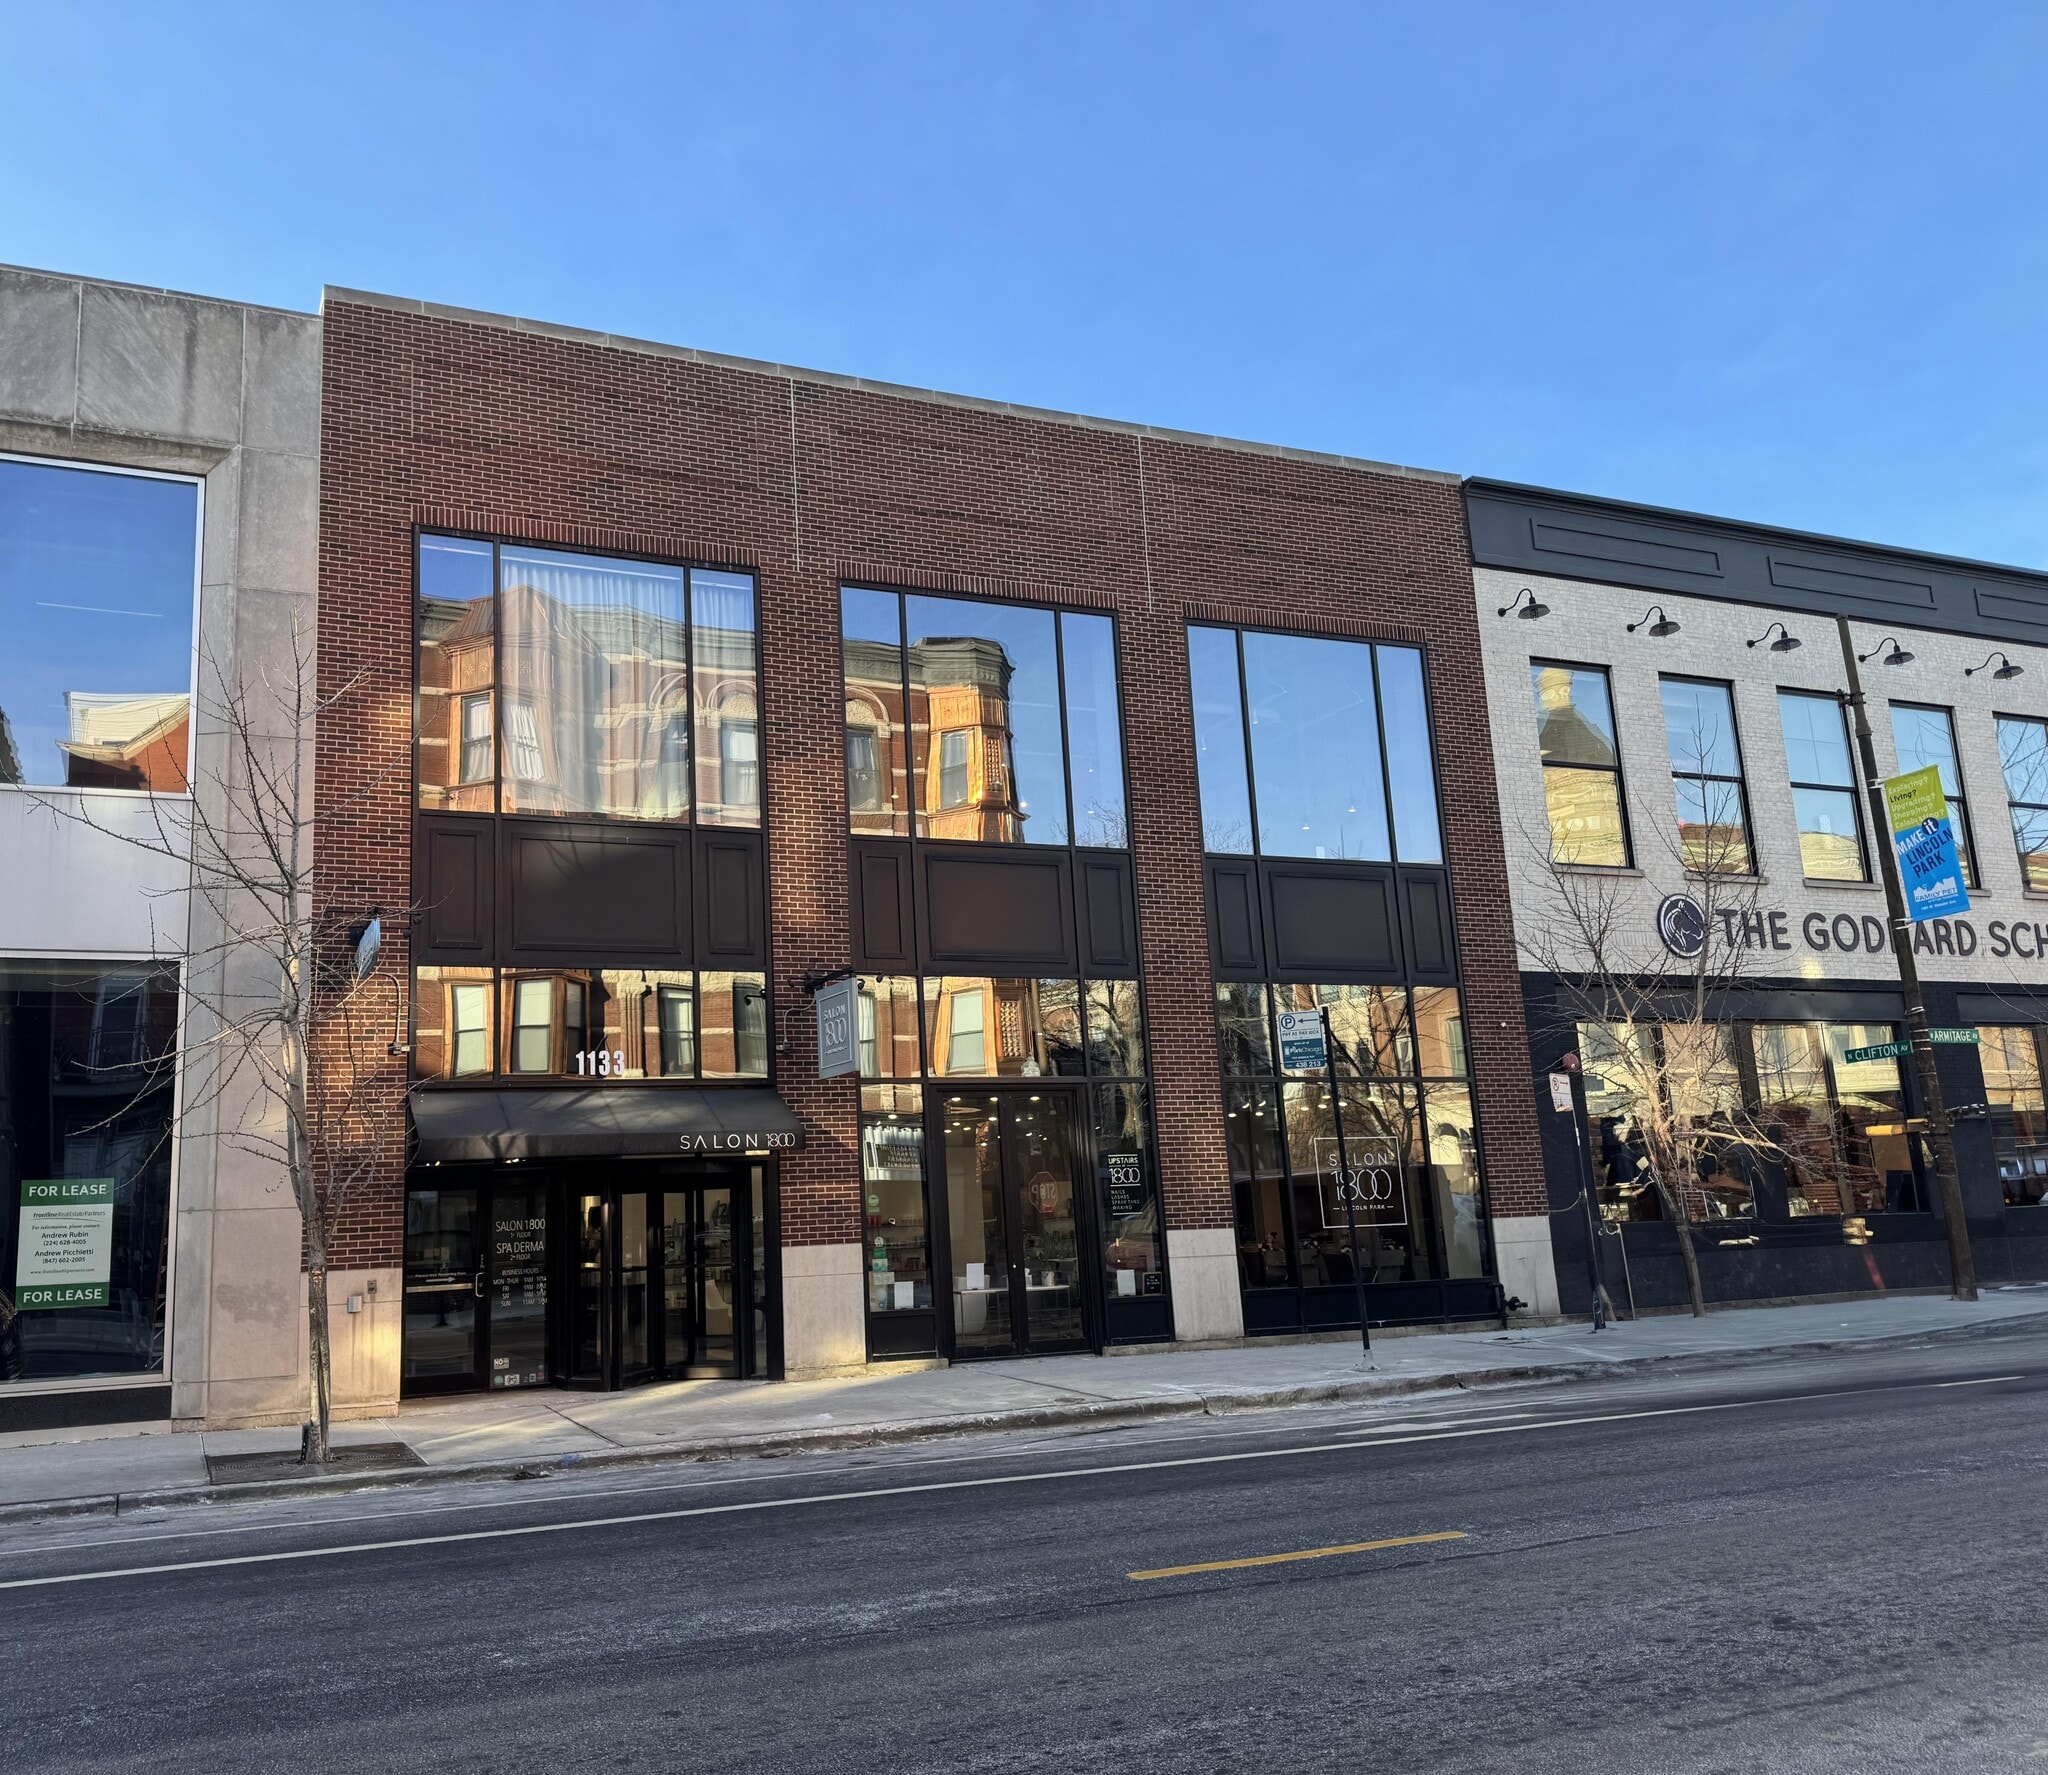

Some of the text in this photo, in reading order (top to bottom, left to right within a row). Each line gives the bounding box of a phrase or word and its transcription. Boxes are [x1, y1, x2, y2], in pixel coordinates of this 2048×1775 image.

[1888, 776, 1928, 795] Exploring?
[1890, 789, 1916, 803] Living?
[1891, 793, 1936, 812] Upgrading?
[1893, 803, 1933, 821] Shopping?
[1896, 820, 1938, 856] MAKE it
[1906, 827, 1954, 865] LINCOLN
[1913, 851, 1946, 878] PARK
[1915, 890, 1940, 901] FAMILY
[1942, 887, 1956, 895] PET
[1715, 908, 1792, 950] THE
[1802, 912, 1977, 956] GODARD
[823, 1004, 846, 1020] SALON
[824, 1017, 847, 1046] 1800
[1934, 1030, 1972, 1042] ARMITAGE
[1855, 1044, 1898, 1060] CLIFTON
[575, 1050, 624, 1076] 1133
[679, 1132, 795, 1150] SALON 1800
[1329, 1153, 1388, 1166] SLON
[1108, 1167, 1140, 1184] 1800
[28, 1184, 107, 1197] FOR LEASE
[1330, 1168, 1392, 1201] 1800
[495, 1219, 546, 1232] SALON 1800
[62, 1248, 94, 1256] Picchietti
[496, 1241, 545, 1254] SPA DERMA
[23, 1289, 102, 1303] FOR LEASE
